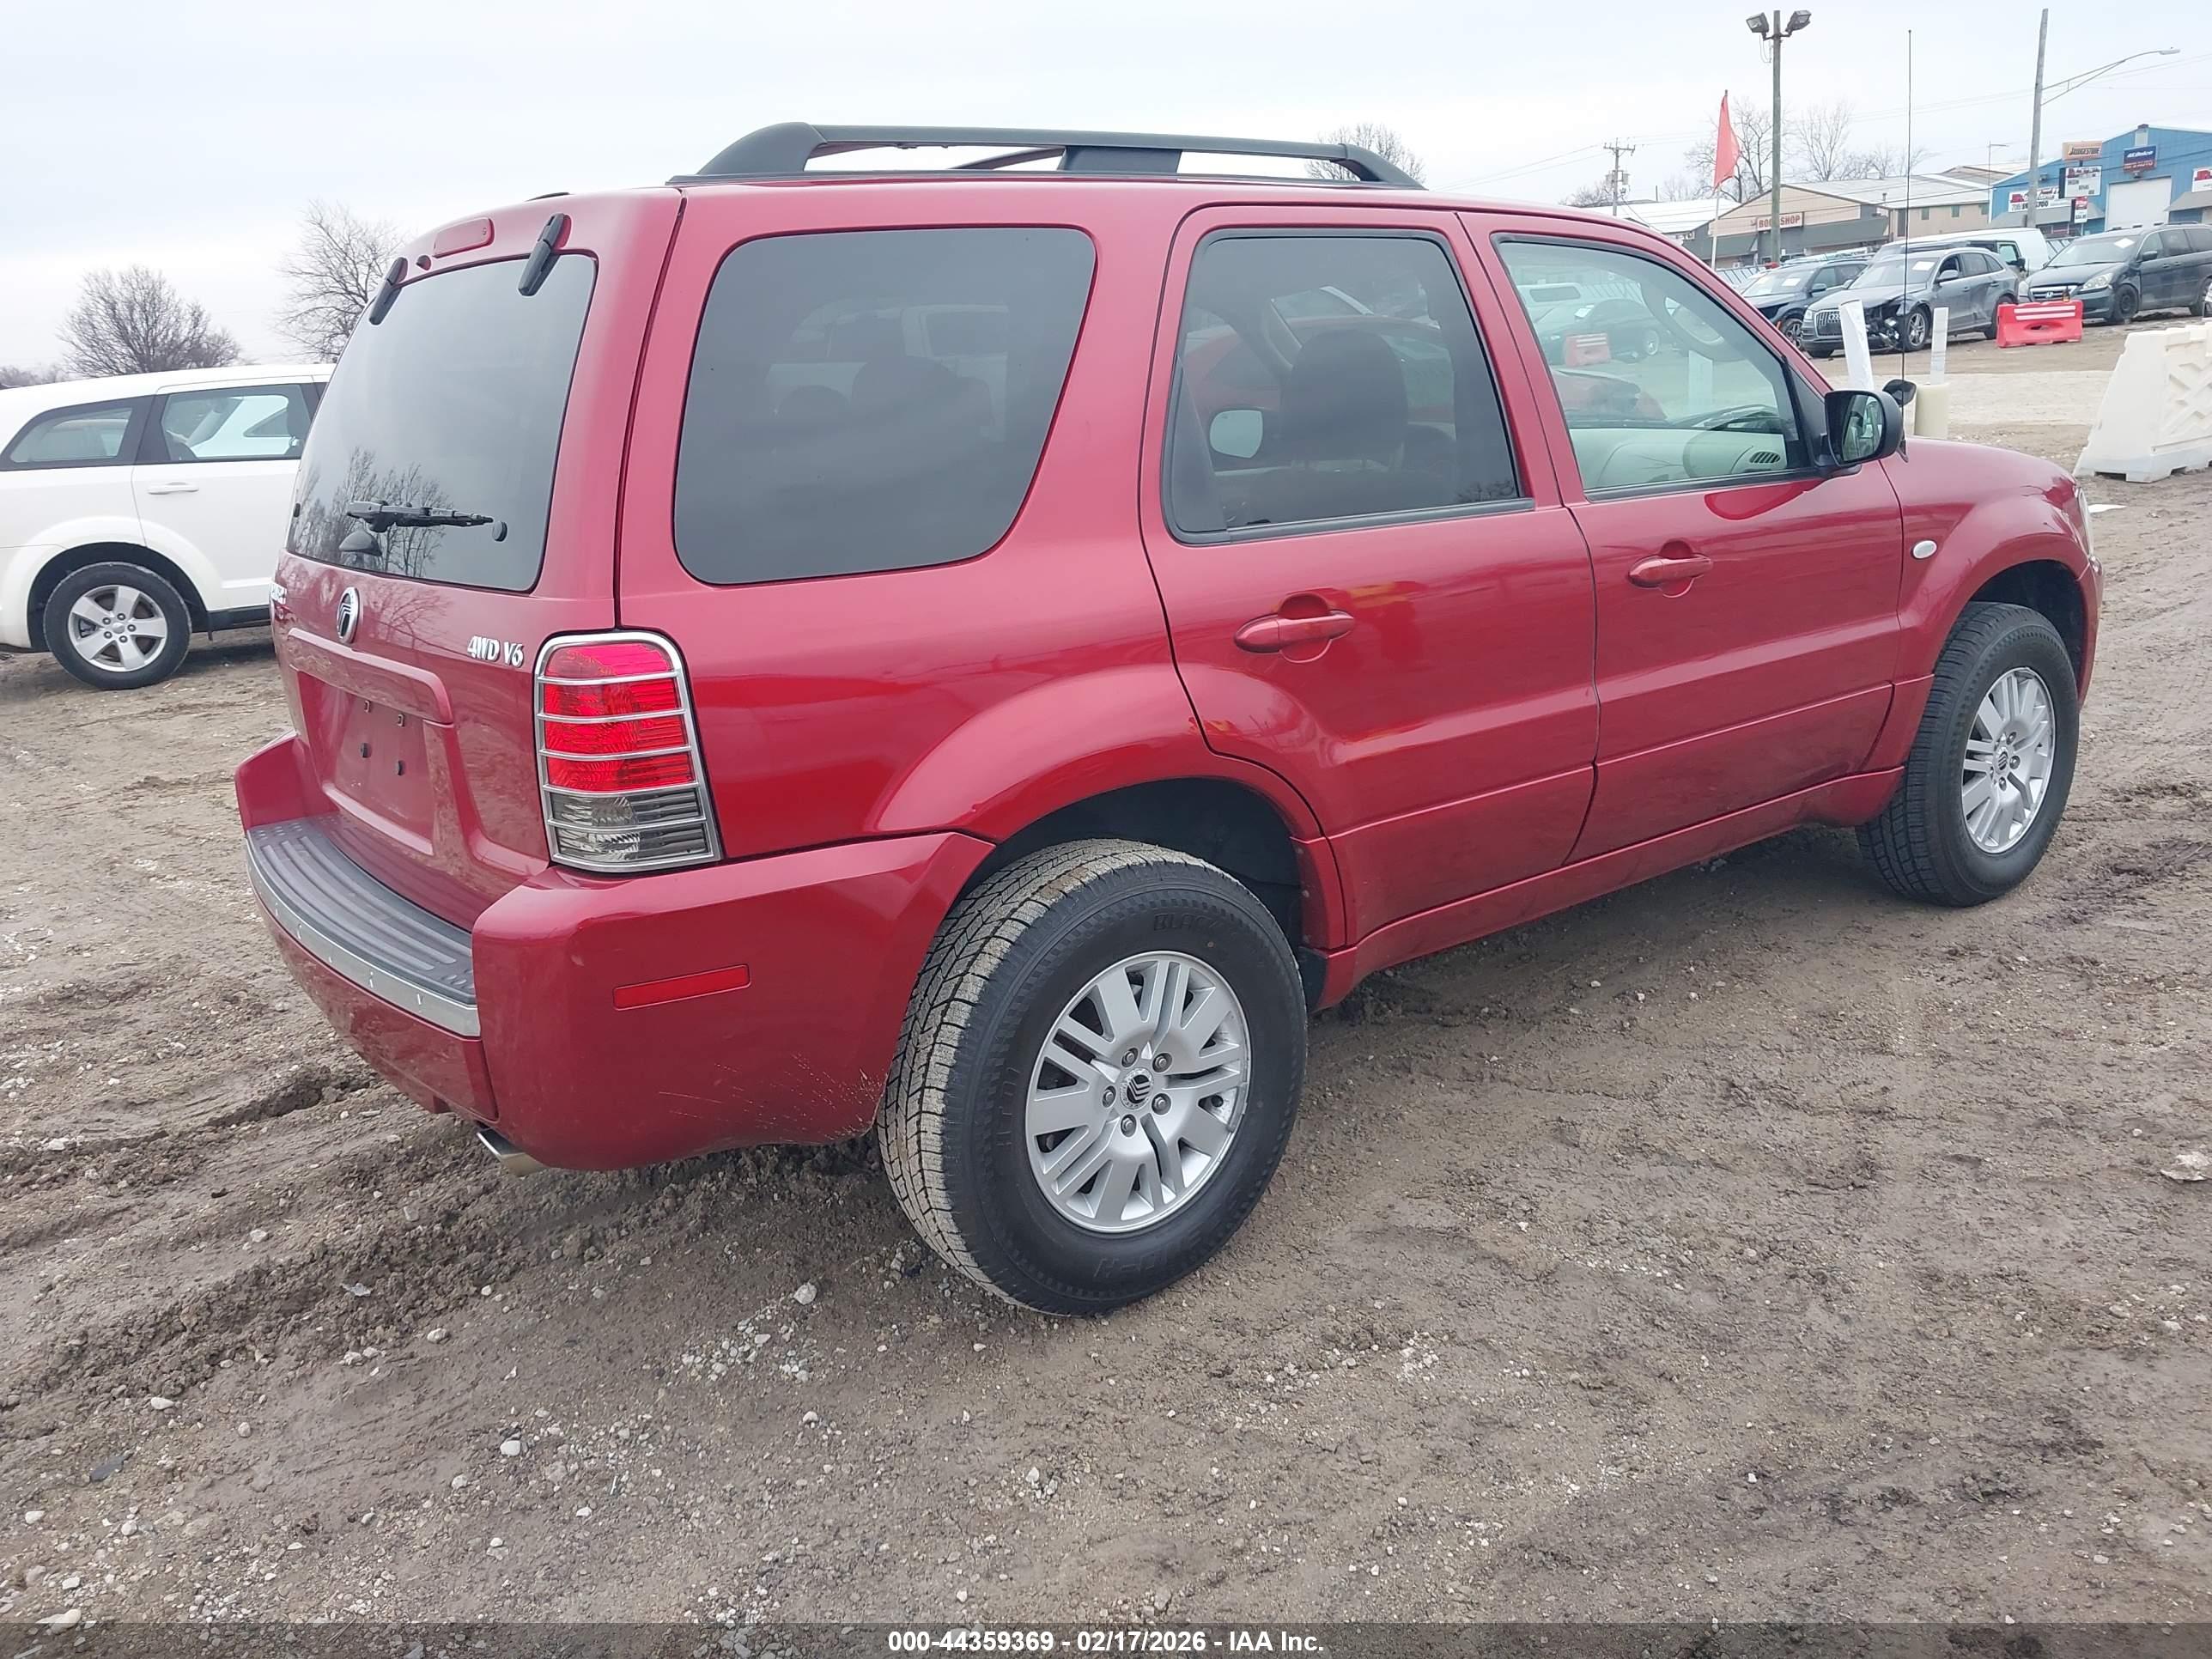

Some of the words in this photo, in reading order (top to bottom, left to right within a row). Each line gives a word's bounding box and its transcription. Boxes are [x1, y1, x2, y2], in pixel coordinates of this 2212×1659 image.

[1780, 215, 1801, 226] SHOP
[467, 635, 501, 662] 4WD
[504, 641, 525, 668] V6
